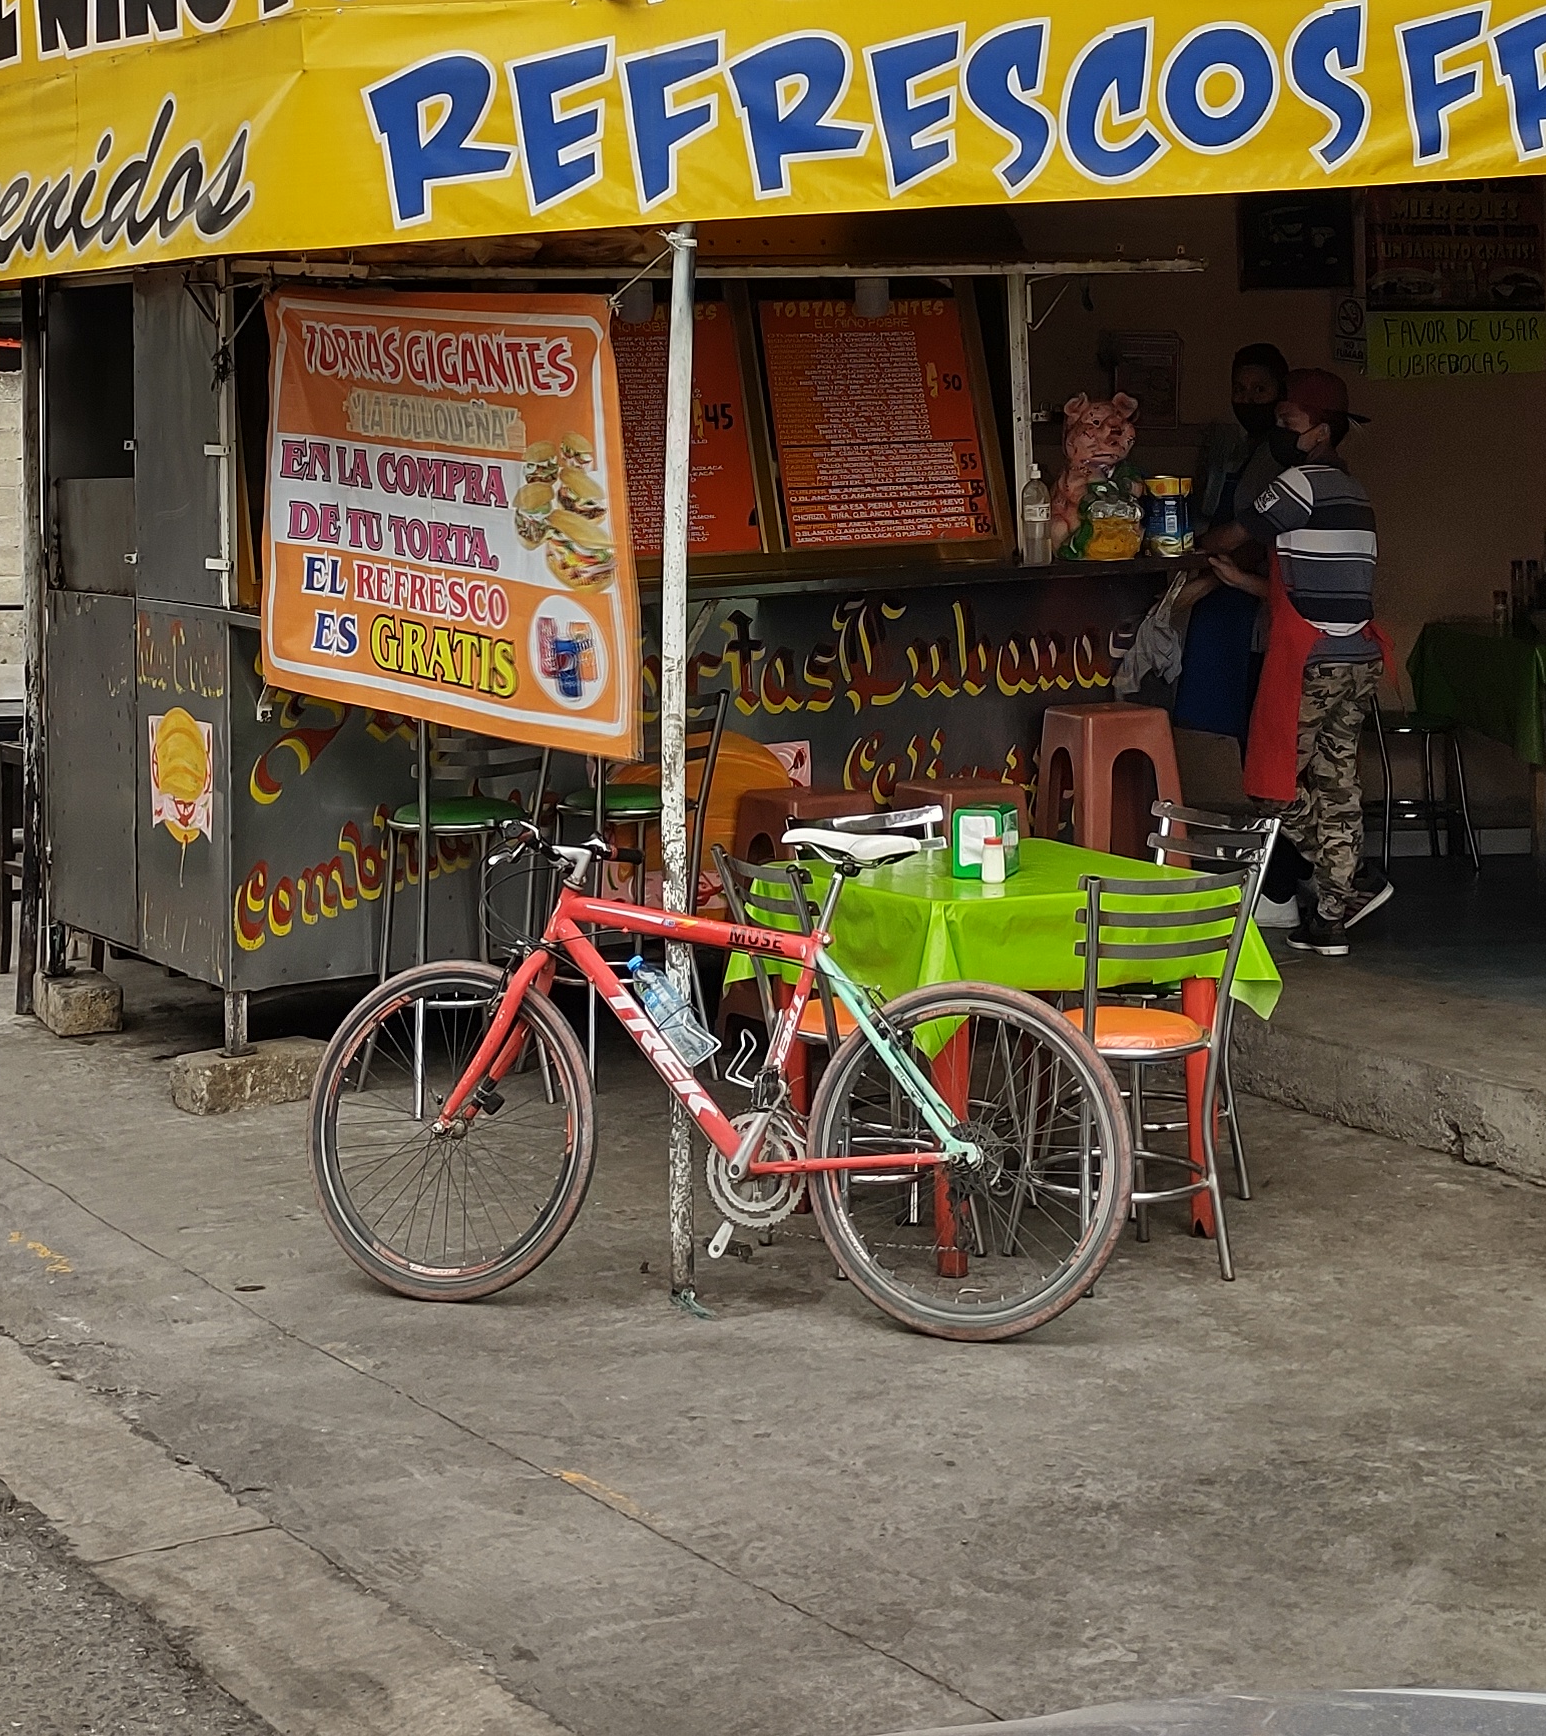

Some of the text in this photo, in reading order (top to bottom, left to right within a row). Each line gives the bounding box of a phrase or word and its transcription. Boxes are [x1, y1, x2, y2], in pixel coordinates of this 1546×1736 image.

[1391, 198, 1520, 220] MIERCOLES
[773, 301, 847, 318] TORTAS
[815, 319, 833, 328] EL
[1384, 316, 1540, 348] FAVOR DE USAR
[304, 322, 578, 396] TORTAS GIGANTES
[1386, 350, 1509, 378] CUBREBOCAS
[943, 373, 962, 391] 50
[704, 403, 734, 430] 45
[280, 439, 509, 508] EN LA COMPRA
[959, 453, 978, 470] 55
[287, 500, 500, 571] DE TU TORTA.
[303, 553, 508, 628] EL REFRESCO
[312, 610, 358, 655] ES
[370, 614, 519, 698] GRATIS
[728, 925, 785, 952] MUSE
[608, 994, 719, 1117] TREK
